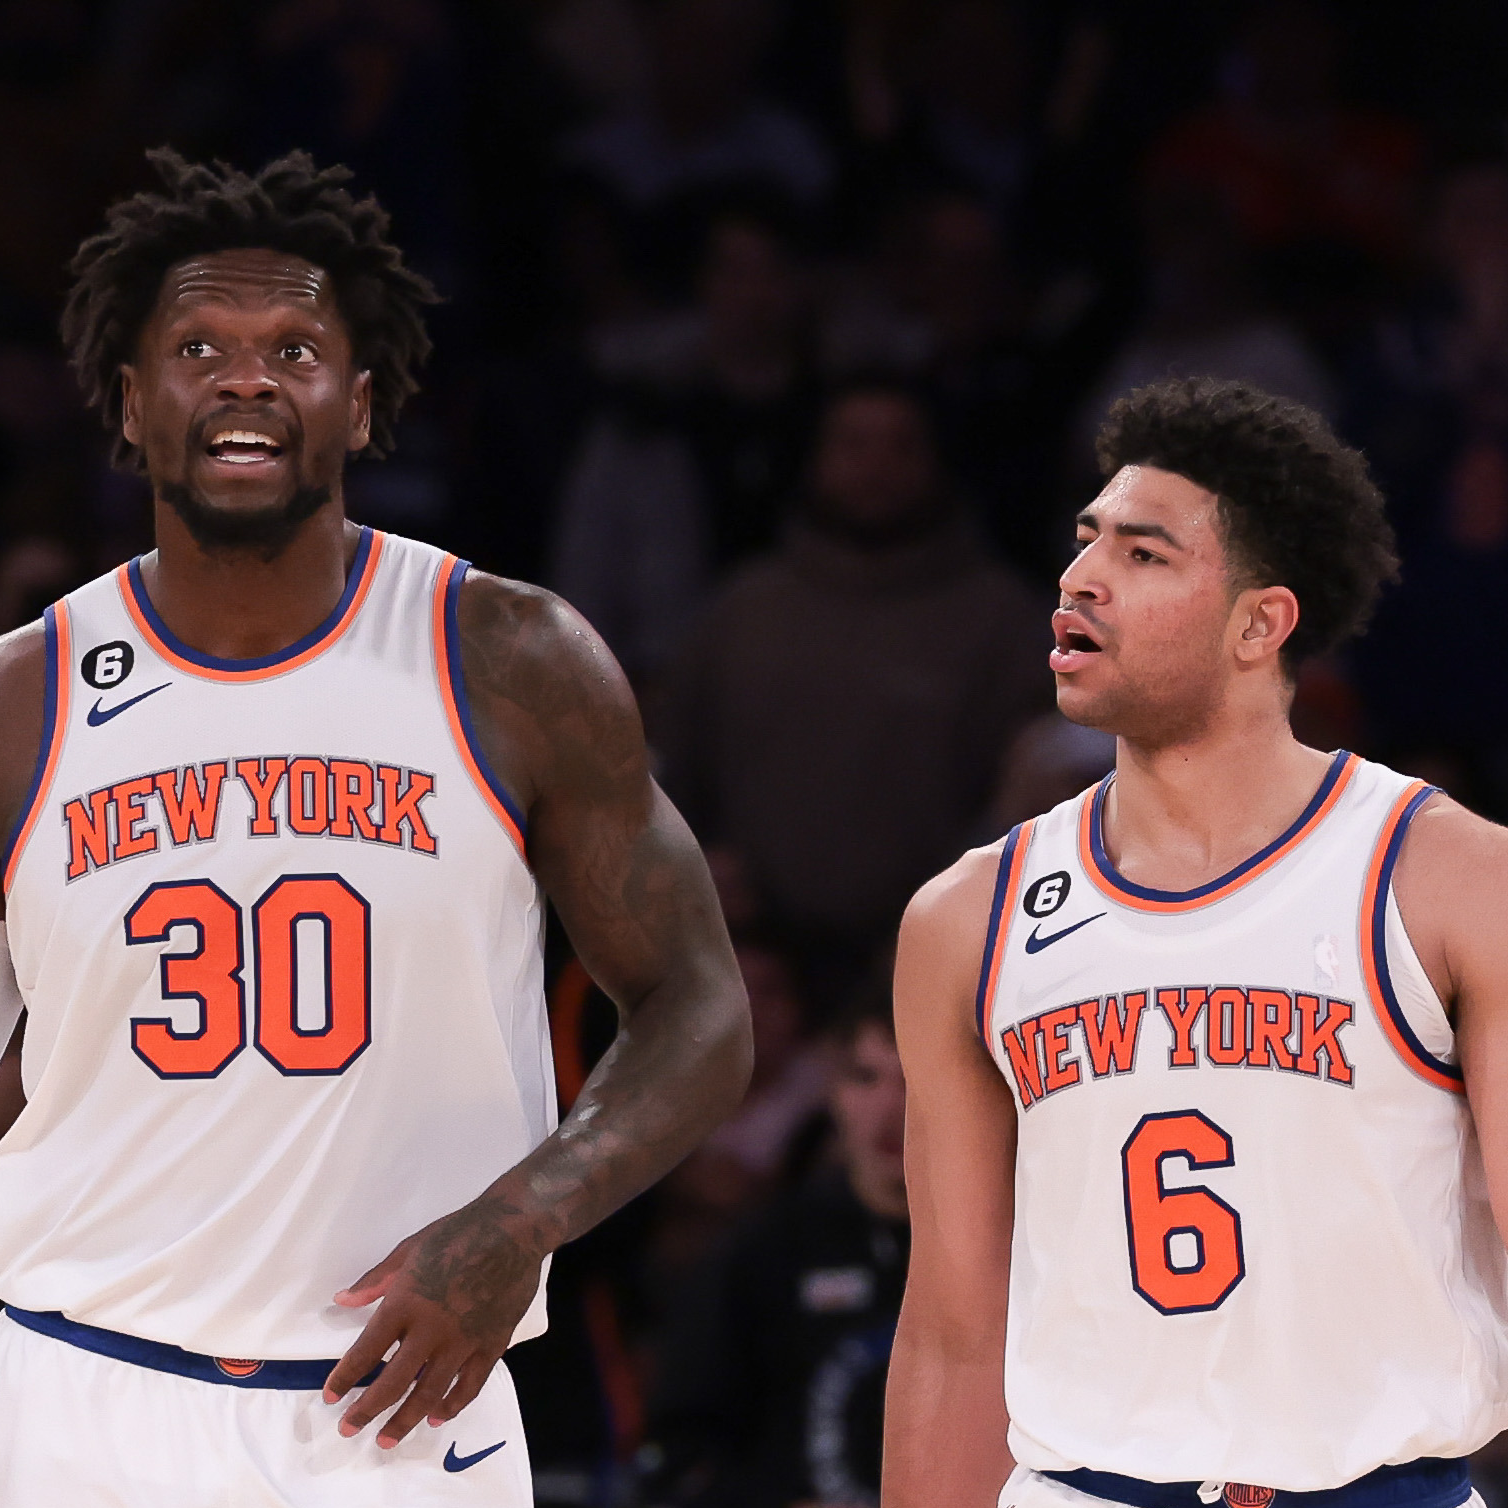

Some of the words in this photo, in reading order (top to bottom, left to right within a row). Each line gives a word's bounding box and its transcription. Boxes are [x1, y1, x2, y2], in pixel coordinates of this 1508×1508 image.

[94, 647, 123, 684] 6
[62, 758, 228, 885] NEW
[234, 754, 440, 859] YORK
[1032, 876, 1063, 912] 6
[124, 873, 372, 1080] 30
[1000, 987, 1149, 1112] NEW
[1155, 984, 1356, 1089] YORK
[1121, 1108, 1246, 1316] 6
